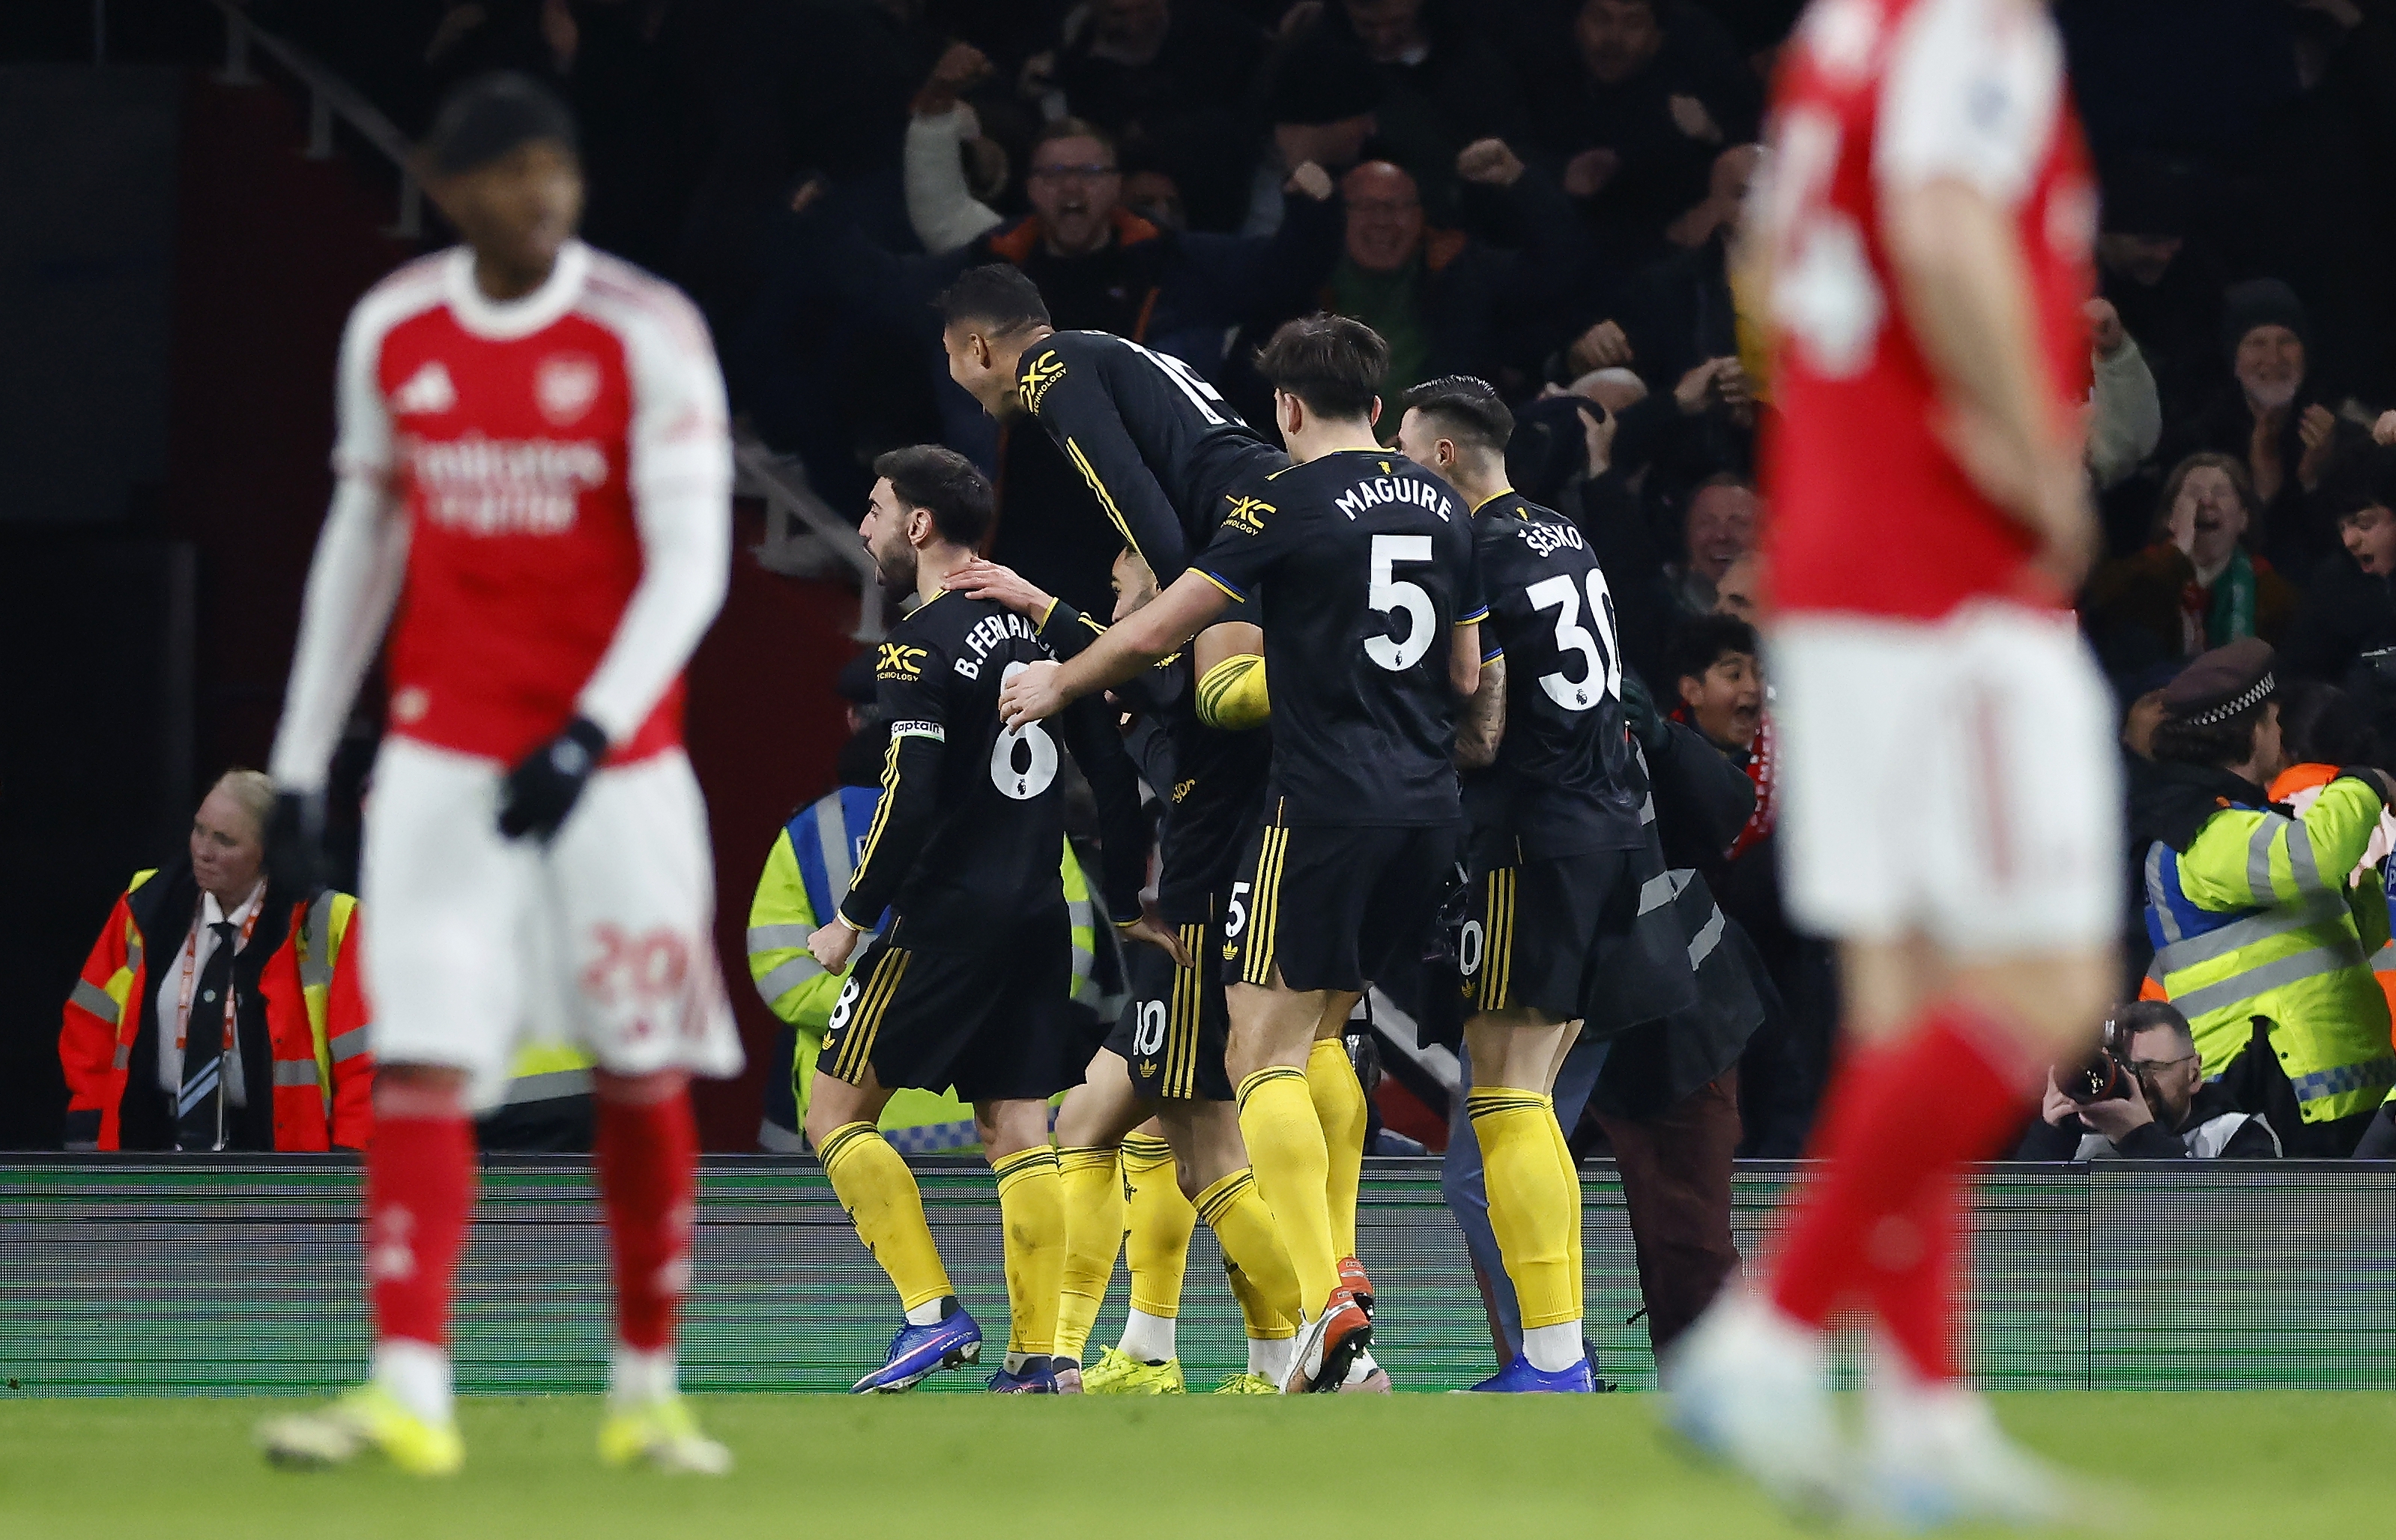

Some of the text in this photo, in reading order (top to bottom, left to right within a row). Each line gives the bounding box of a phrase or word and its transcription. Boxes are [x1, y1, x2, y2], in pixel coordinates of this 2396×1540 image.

[1334, 476, 1453, 522] MAGUIRE
[1364, 534, 1436, 671] 5
[1525, 567, 1623, 712] 30
[1225, 882, 1250, 937] 5
[576, 921, 689, 1008] 20
[829, 975, 860, 1030] 8
[1133, 999, 1167, 1056] 10
